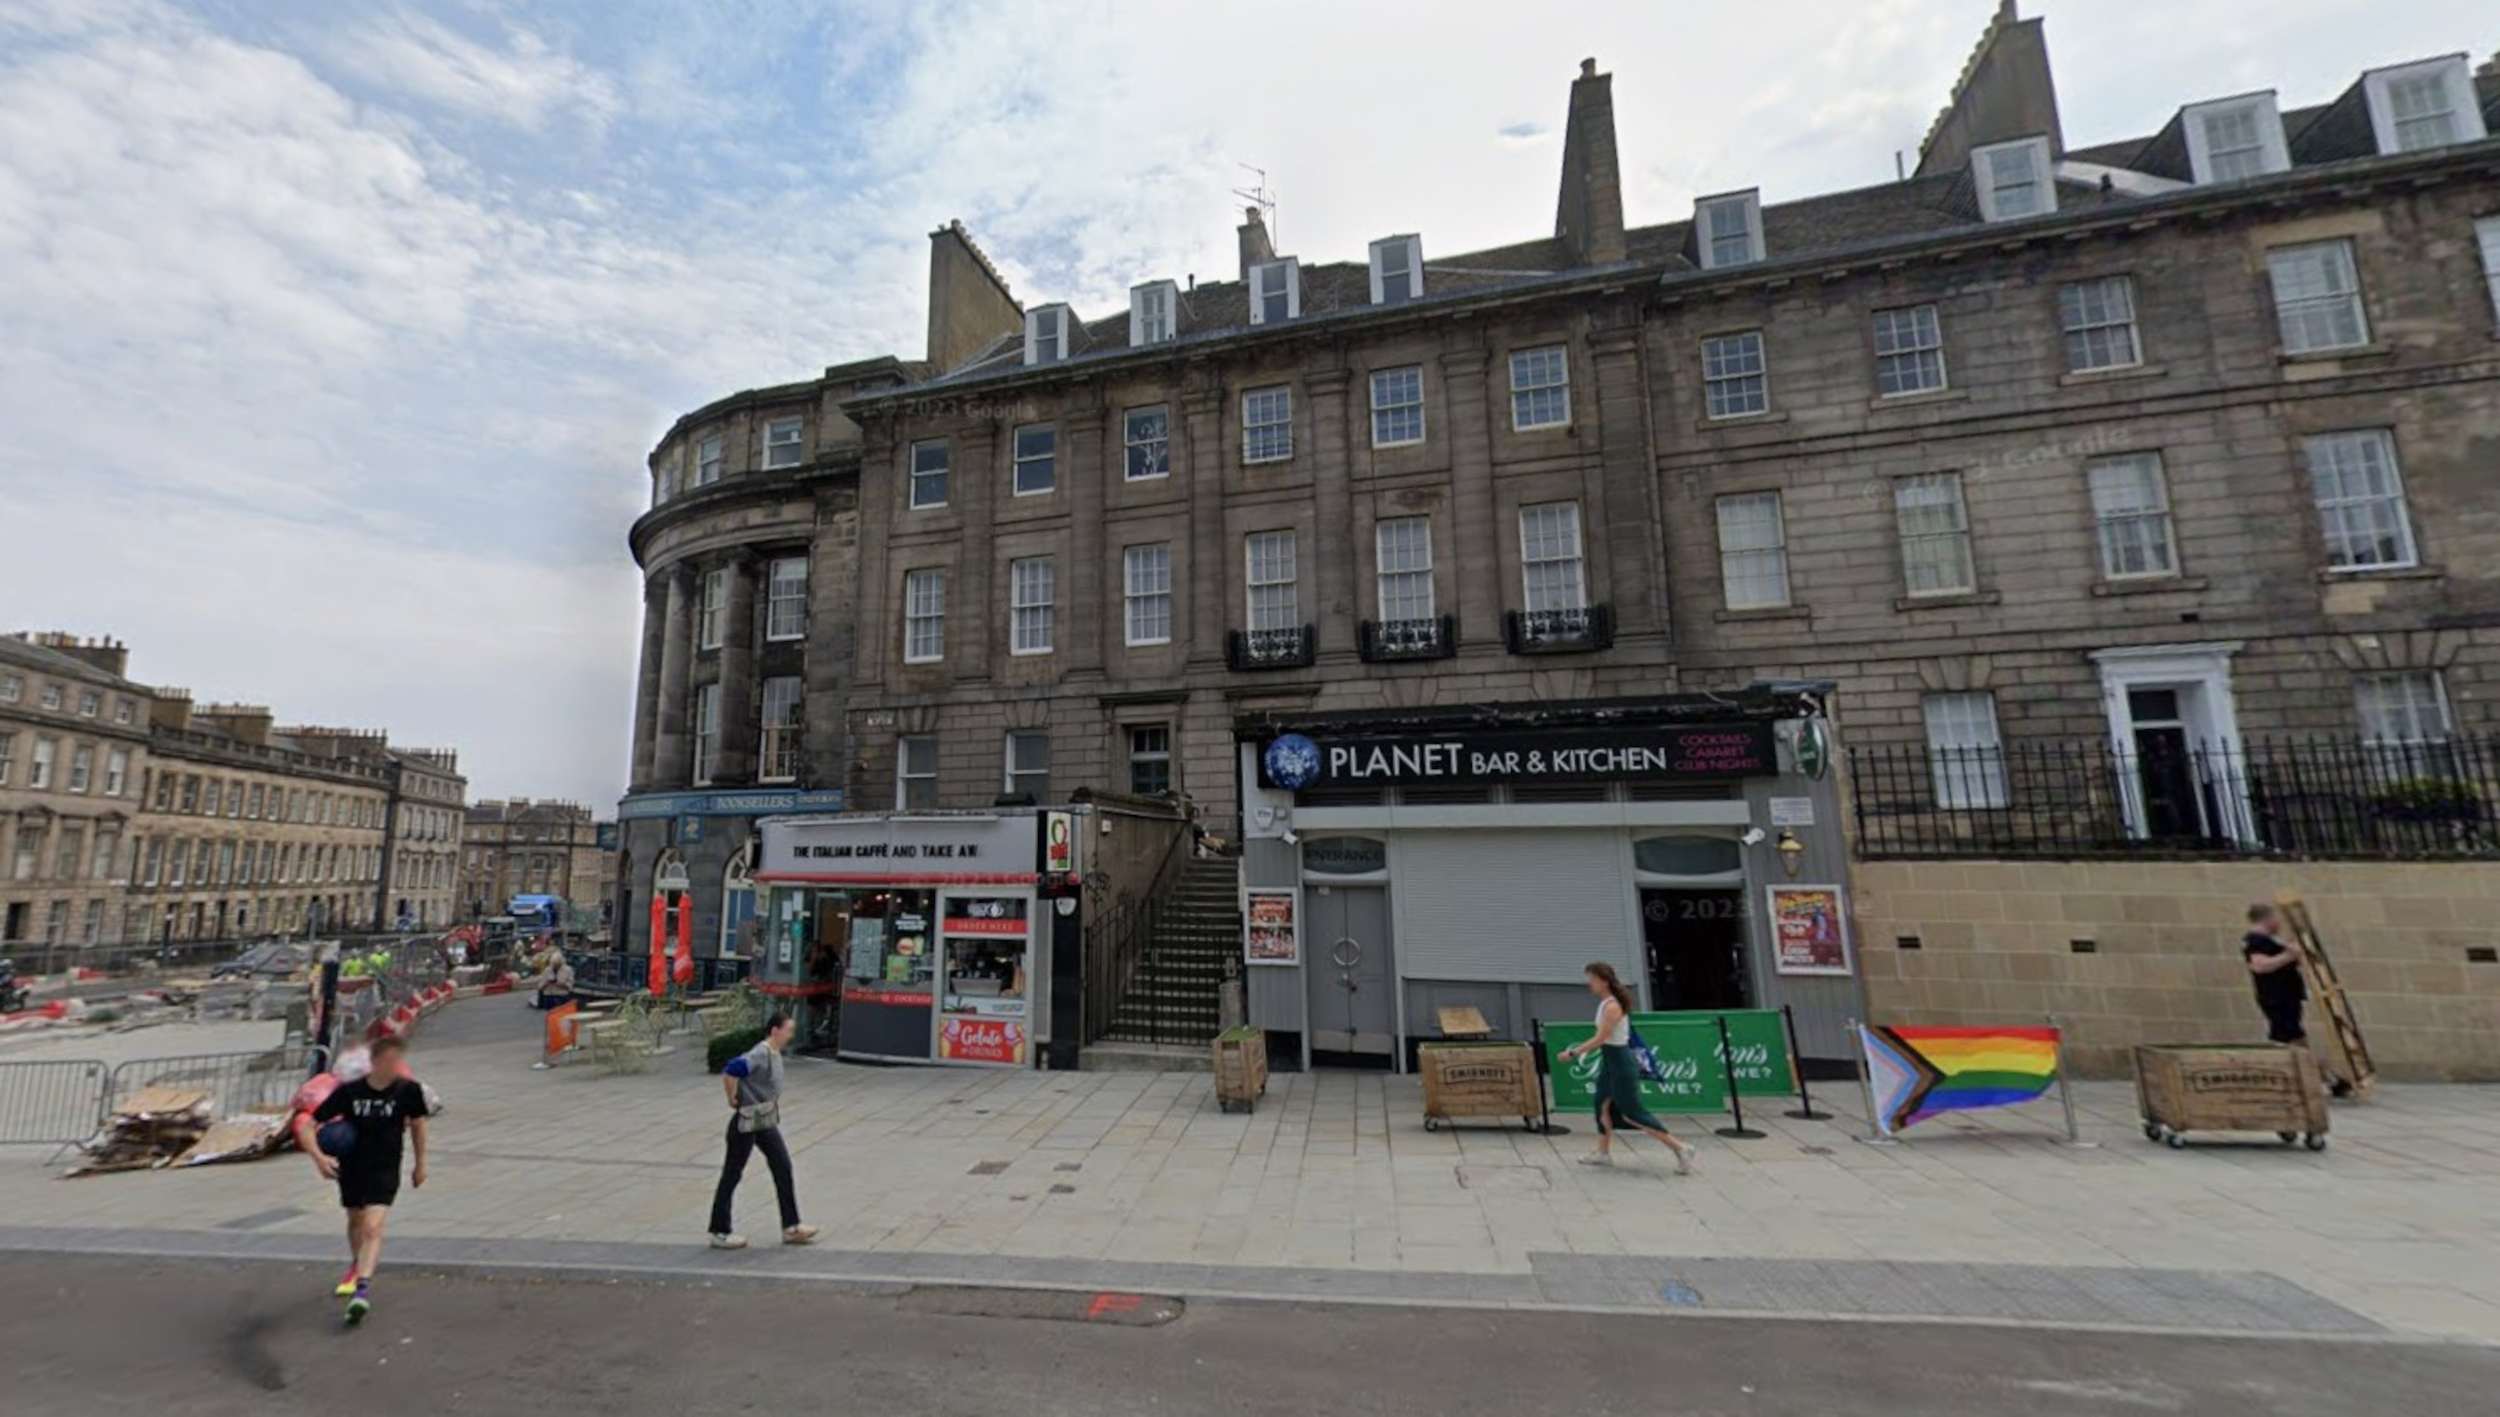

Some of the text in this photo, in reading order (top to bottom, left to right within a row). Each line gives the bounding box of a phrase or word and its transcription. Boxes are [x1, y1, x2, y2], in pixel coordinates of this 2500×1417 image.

[1679, 734, 1753, 745] COCKTAILS
[1686, 746, 1744, 757] CABARET
[1330, 743, 1667, 778] PLANET BAR & KITCHEN
[1710, 757, 1760, 769] NIGHTS
[794, 845, 809, 858] THE
[813, 845, 853, 858] ITALIAN
[892, 845, 916, 857] AND
[922, 845, 953, 857] TAKE
[960, 1024, 1001, 1046] Gelato
[1659, 1082, 1704, 1095] WE?
